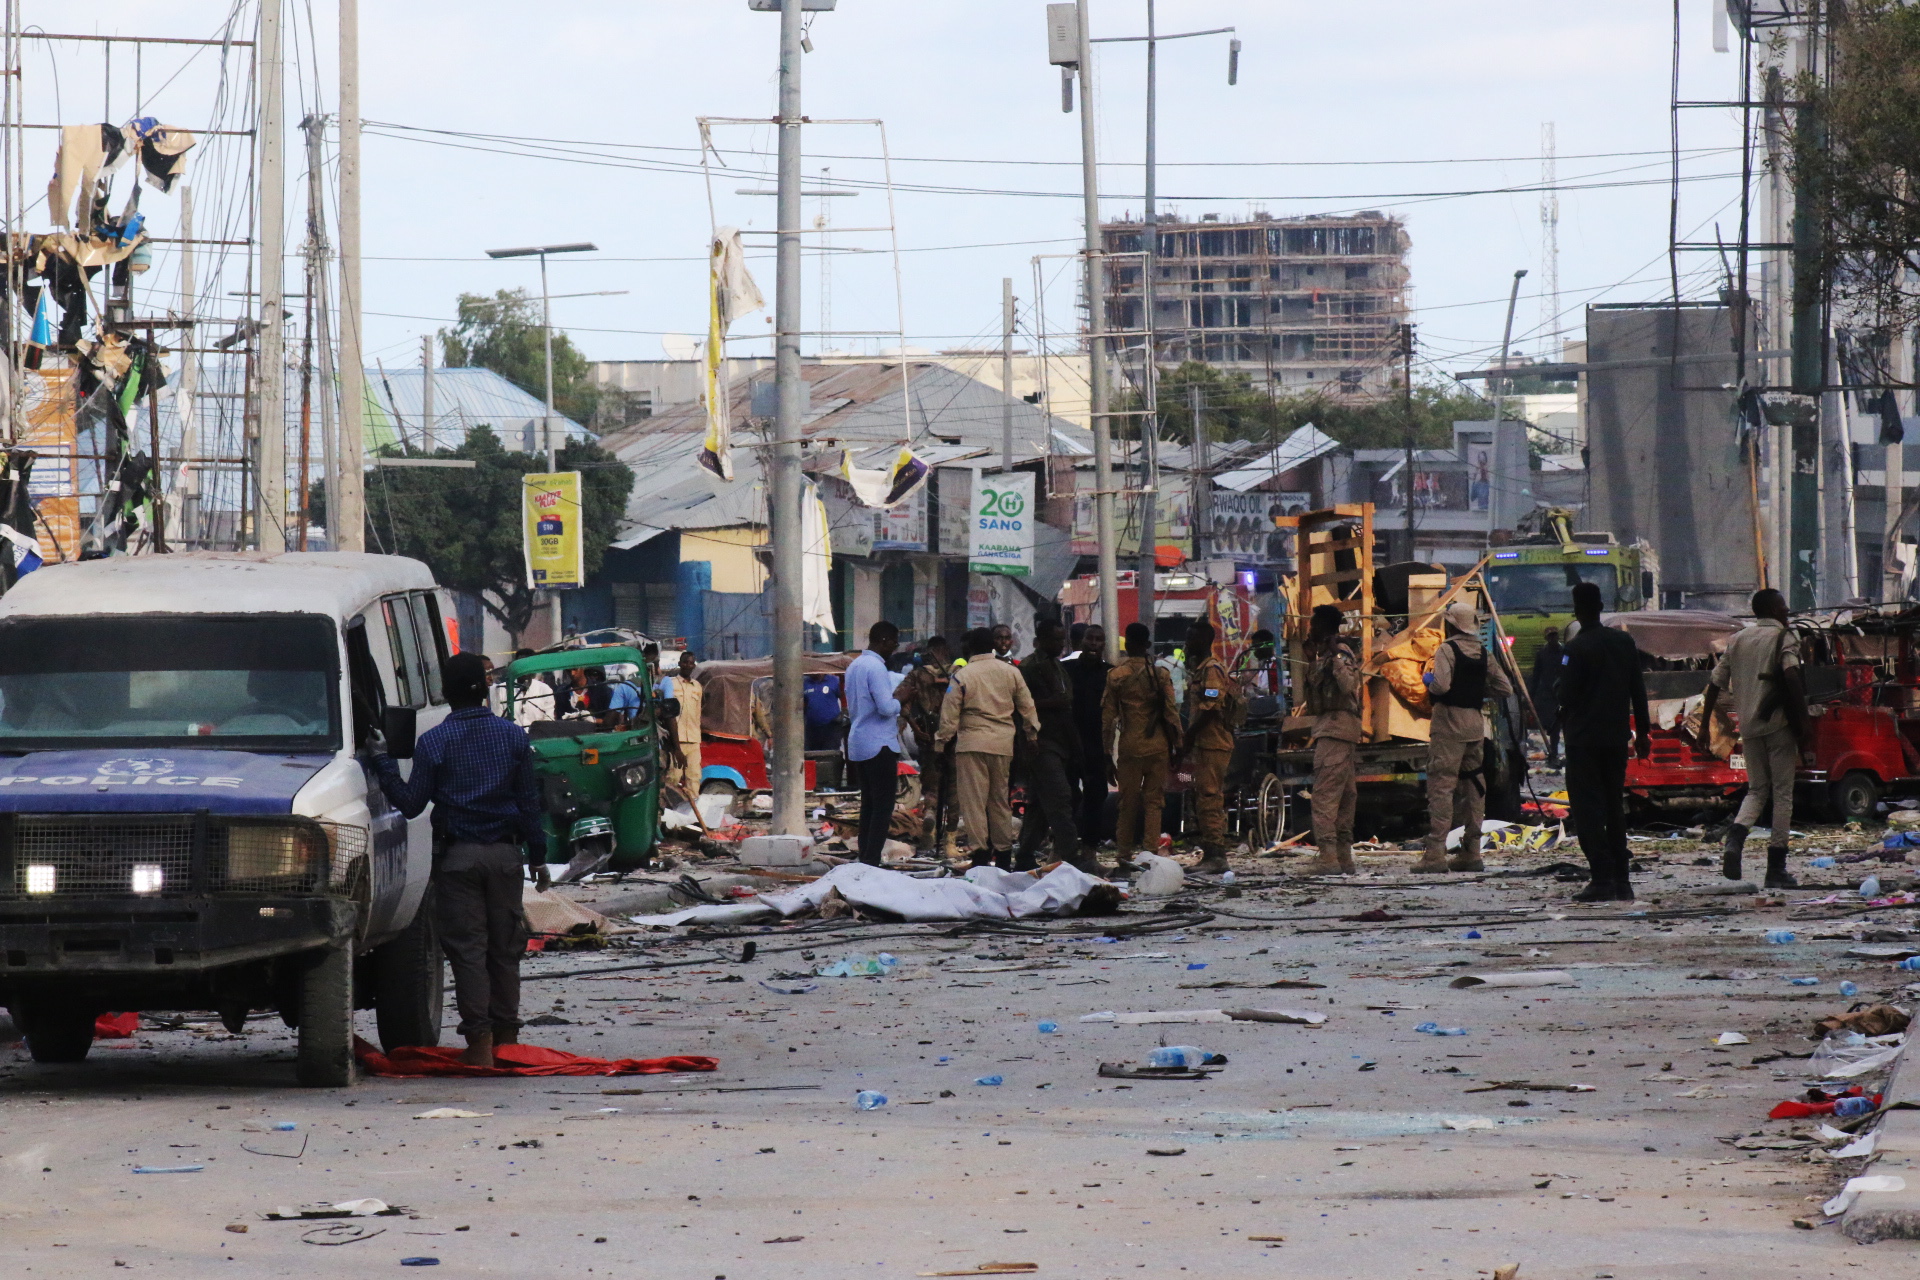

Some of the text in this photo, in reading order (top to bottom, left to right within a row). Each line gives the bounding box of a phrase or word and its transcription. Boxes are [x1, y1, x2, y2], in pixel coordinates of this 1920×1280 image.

[979, 488, 1025, 518] 20
[1249, 495, 1263, 514] OIL
[979, 518, 1022, 531] SANO
[0, 775, 244, 790] POLICE
